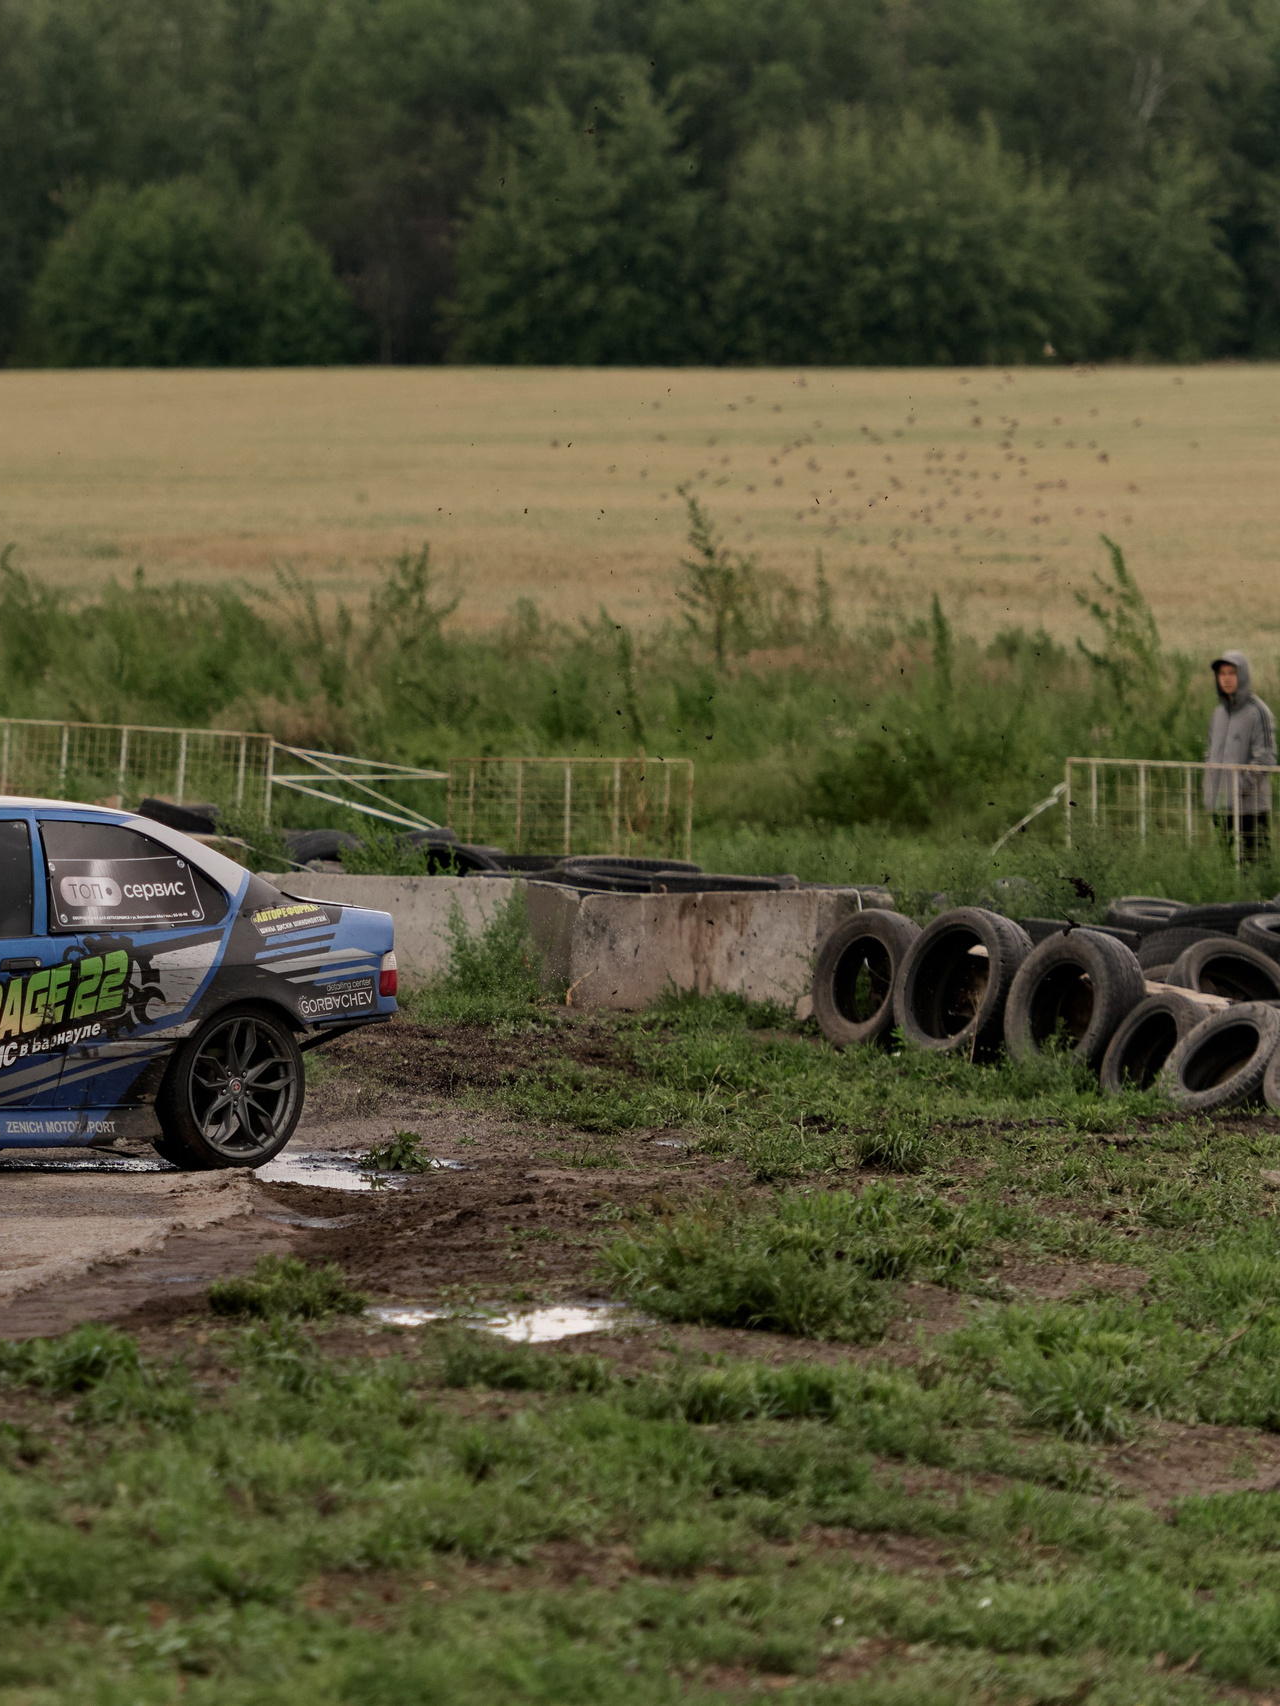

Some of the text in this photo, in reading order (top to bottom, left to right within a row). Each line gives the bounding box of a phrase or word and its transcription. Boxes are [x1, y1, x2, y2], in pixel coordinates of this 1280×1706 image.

[68, 881, 186, 901] ТОП сервис
[70, 950, 129, 1020] 22
[326, 978, 372, 992] detailing center
[6, 1121, 115, 1134] ZENICH MOTOPORT
